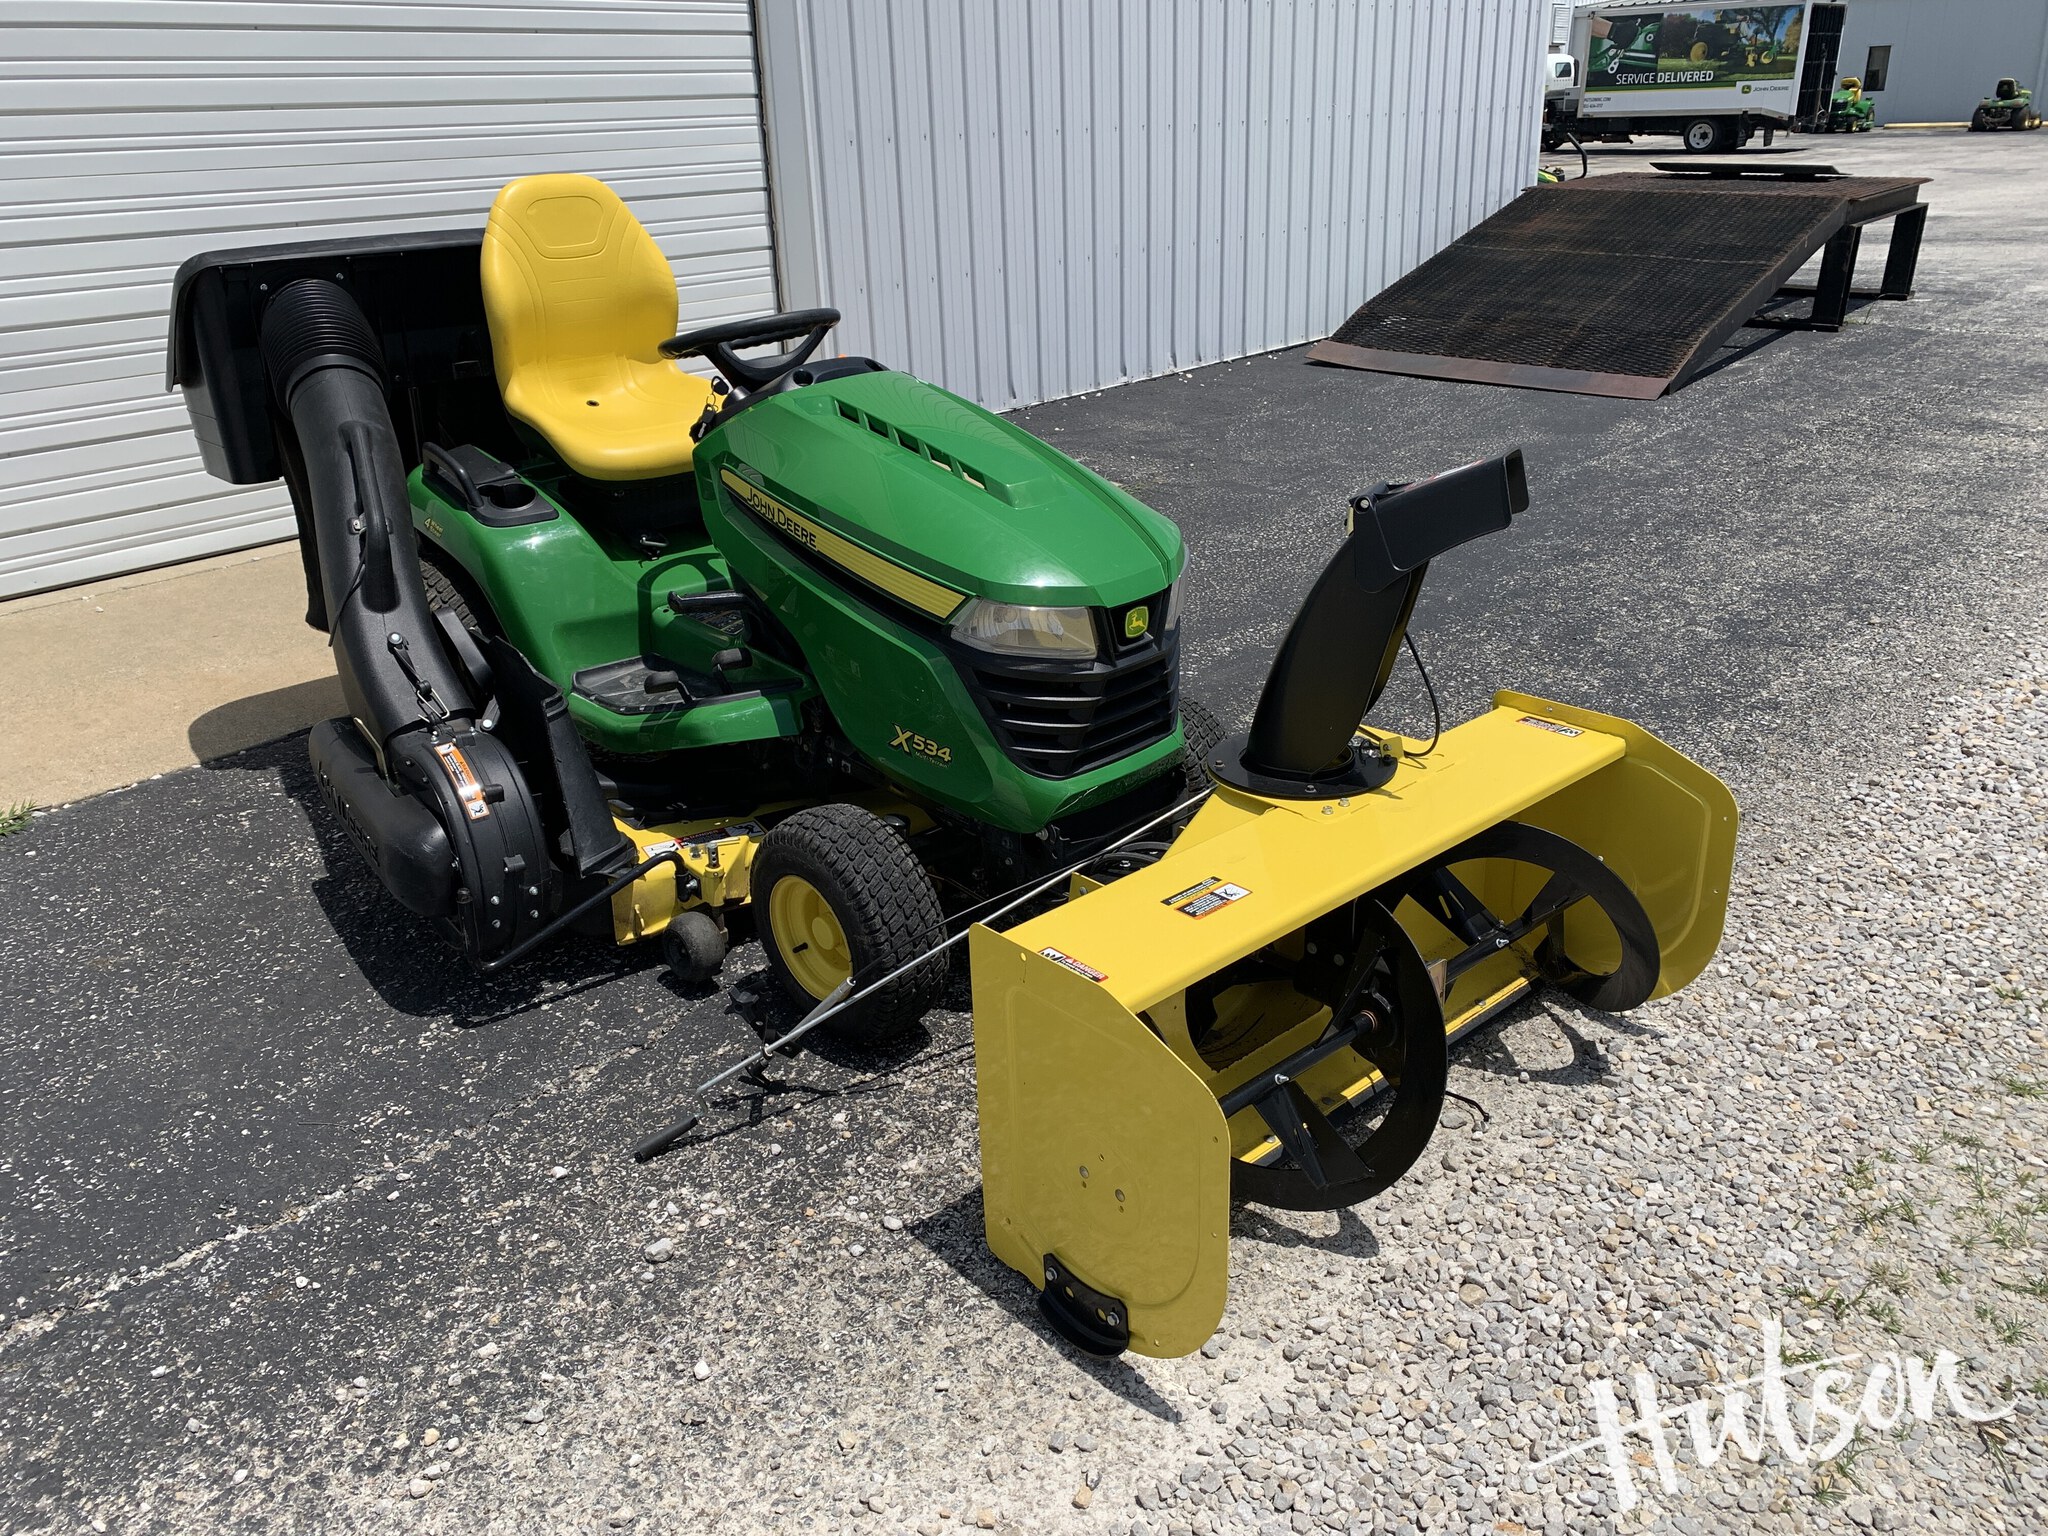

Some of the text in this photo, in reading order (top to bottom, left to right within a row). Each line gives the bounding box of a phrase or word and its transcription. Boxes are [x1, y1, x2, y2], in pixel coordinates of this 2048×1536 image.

[1615, 70, 1714, 85] SERVICE DELIVERED
[747, 488, 818, 549] JOHN DEERE
[889, 724, 952, 762] X534
[1073, 960, 1106, 979] DANGER
